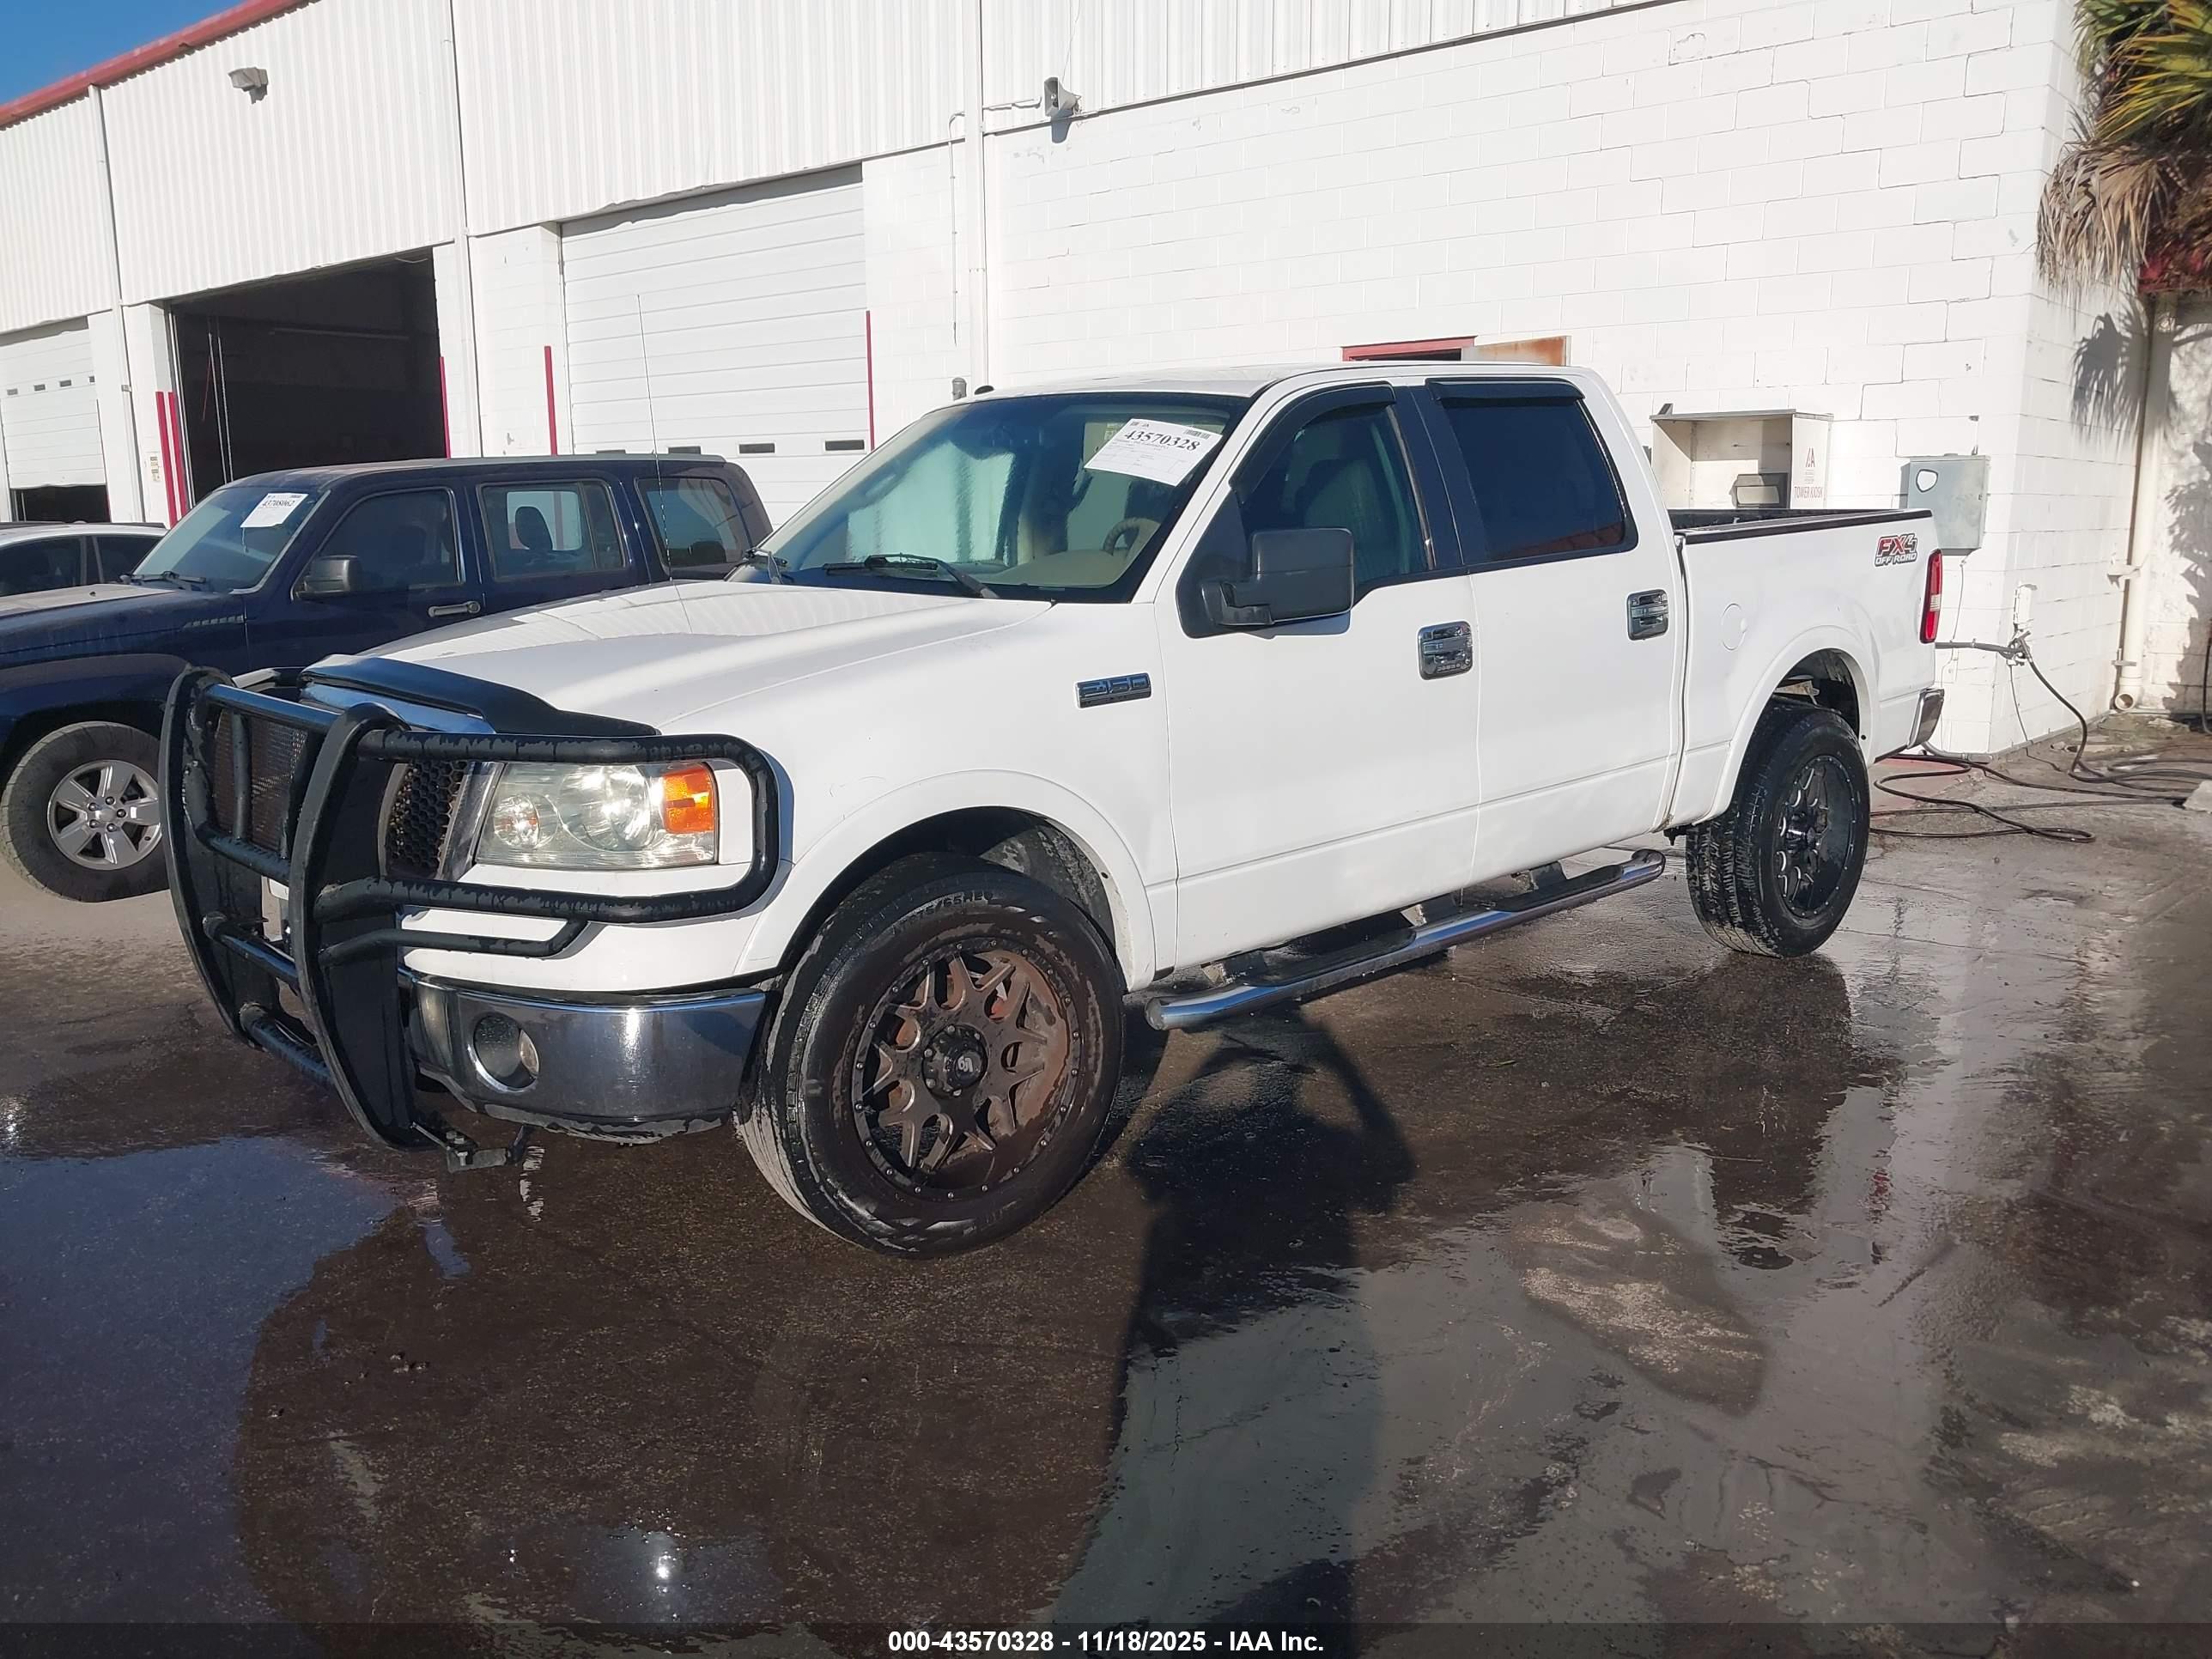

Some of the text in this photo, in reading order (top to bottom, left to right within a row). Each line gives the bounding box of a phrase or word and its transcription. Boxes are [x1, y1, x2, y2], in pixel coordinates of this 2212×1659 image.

[1124, 429, 1200, 451] 43570328
[1794, 486, 1823, 499] TOWER KIOSK
[1877, 534, 1917, 556] FX4
[1875, 552, 1917, 566] OFF ROAD
